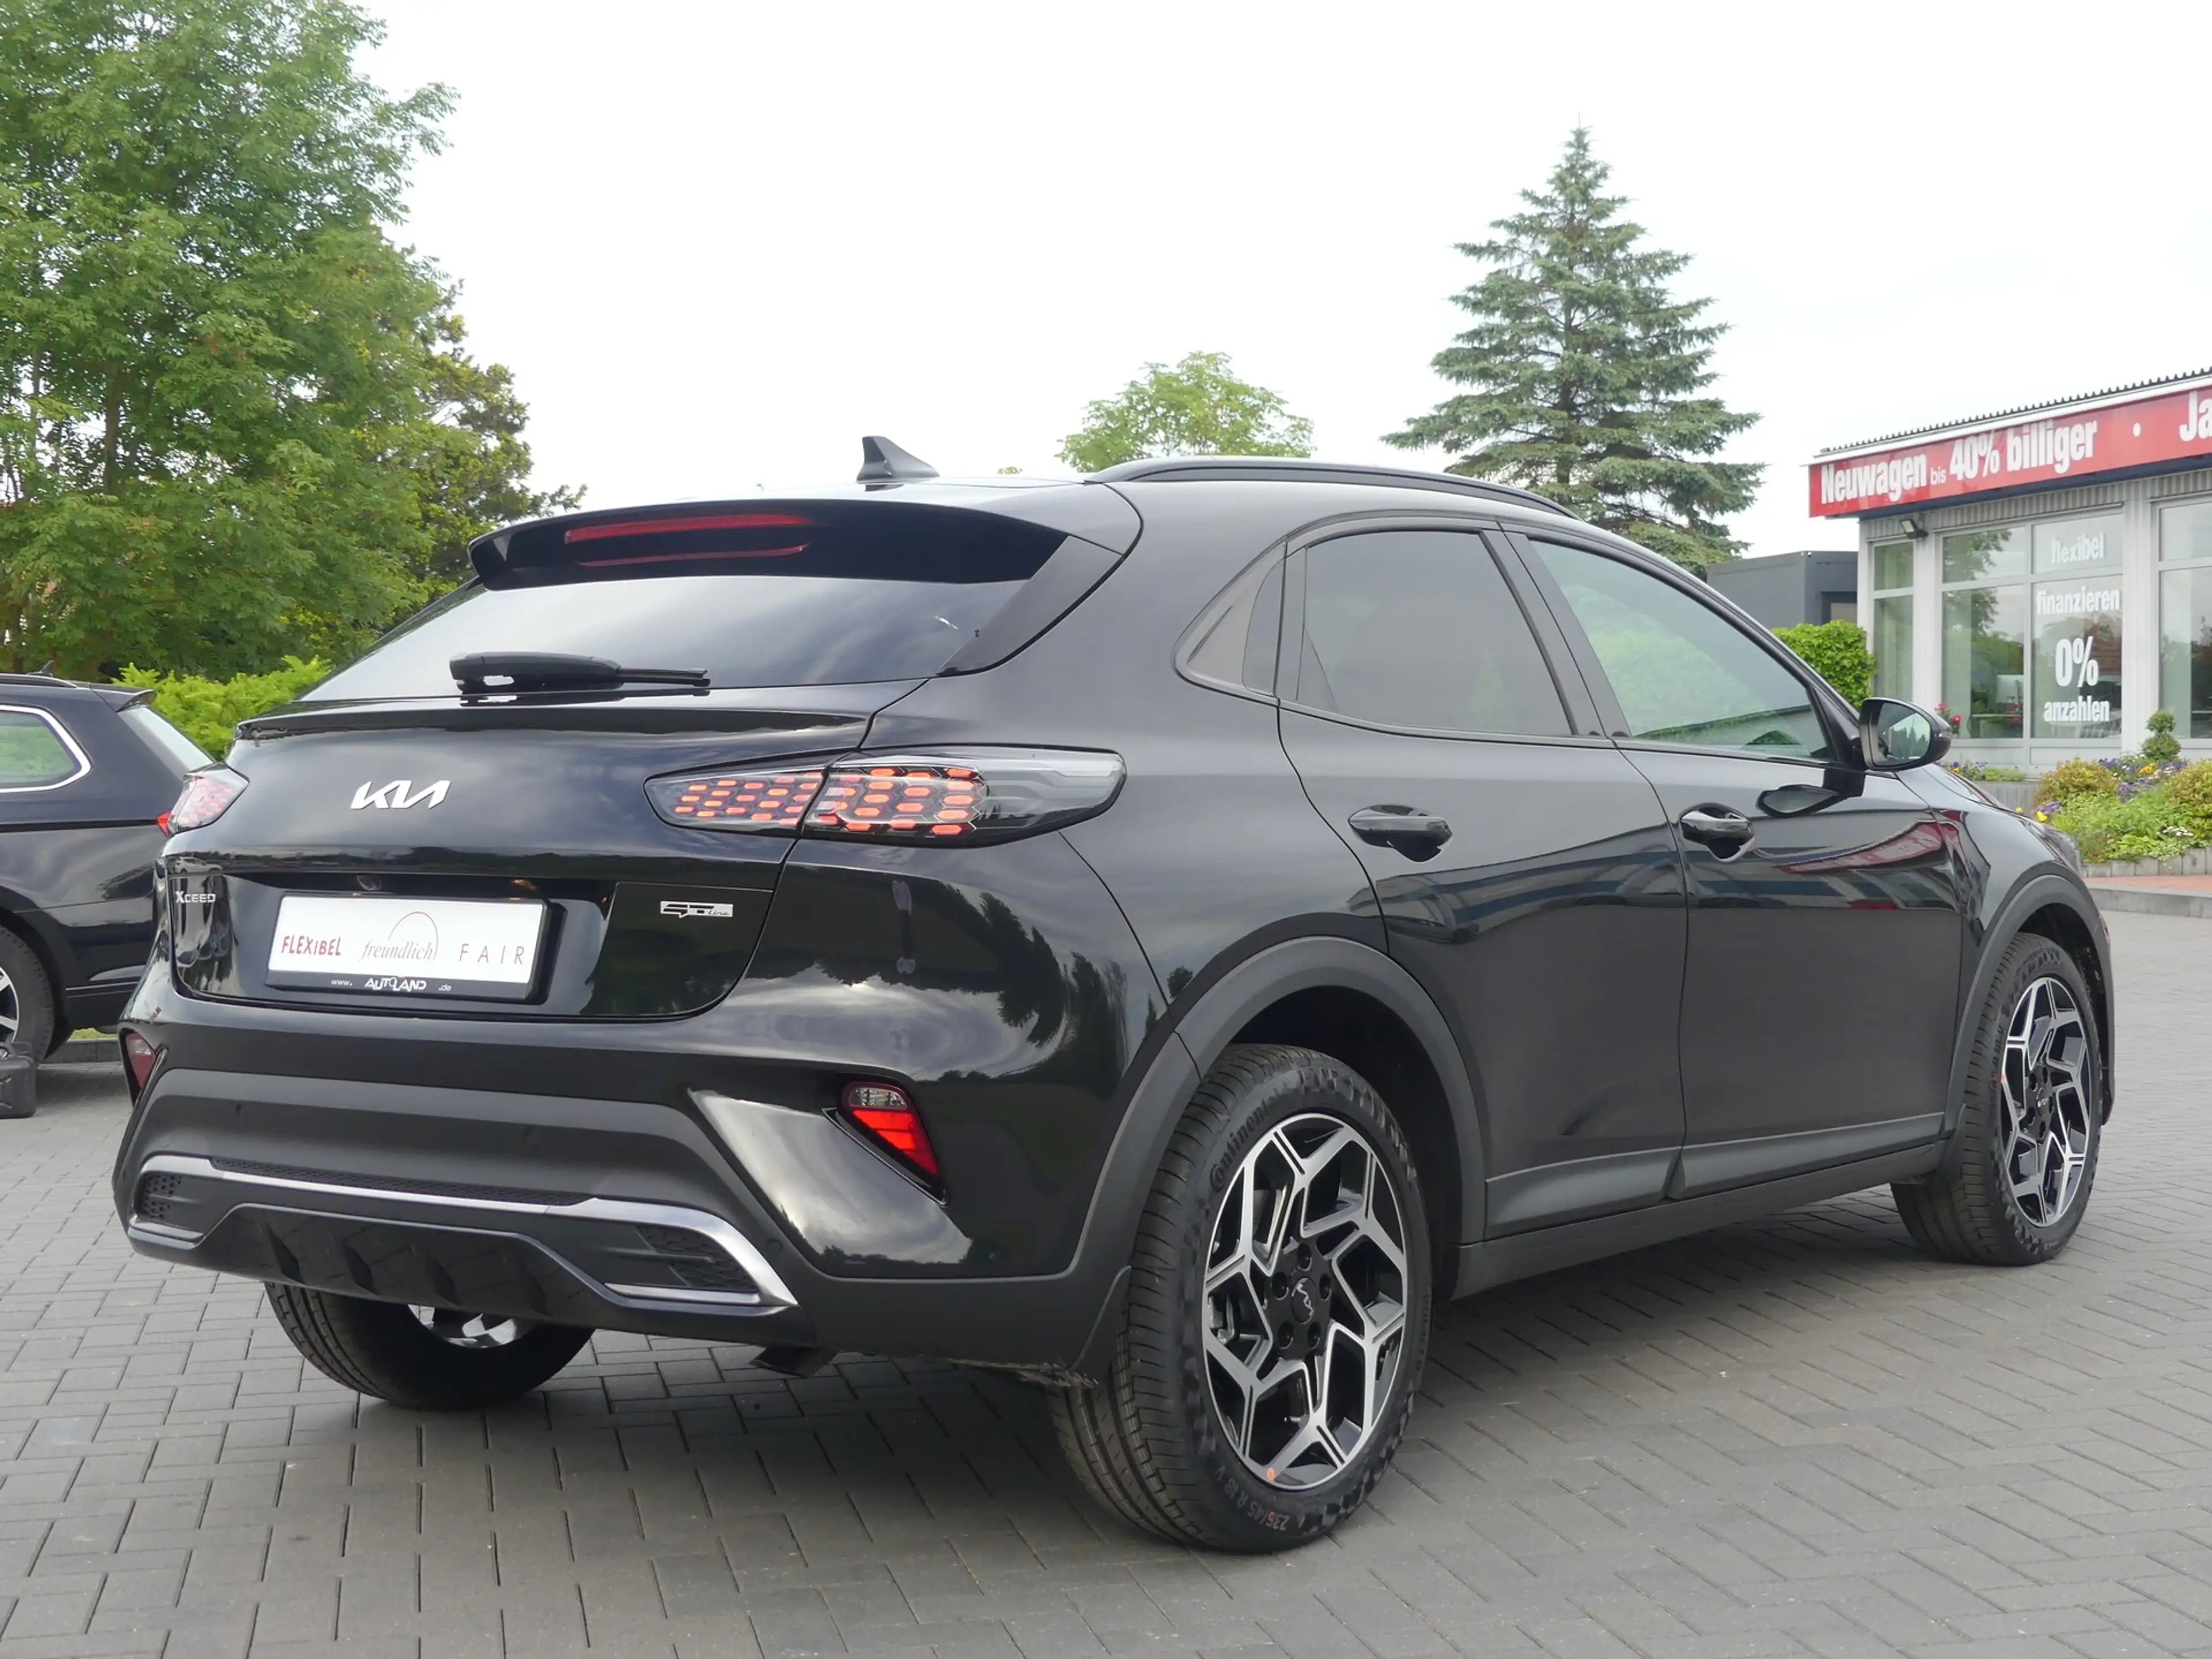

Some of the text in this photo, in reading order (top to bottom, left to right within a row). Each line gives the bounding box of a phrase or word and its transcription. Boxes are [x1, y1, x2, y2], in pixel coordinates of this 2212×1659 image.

[1820, 454, 1927, 505] Neuwagen
[1930, 466, 1946, 485] bis
[1949, 430, 2000, 480] 40%
[2007, 419, 2097, 474] billiger
[2051, 532, 2106, 564] flexibel
[2036, 585, 2120, 616] finanzieren
[2055, 636, 2099, 687] 0%
[2044, 695, 2109, 722] anzahlen
[350, 780, 451, 810] KIA
[281, 935, 342, 956] FLEXIBEL
[358, 940, 437, 962] freundlich
[364, 977, 427, 992] AUTOLAND
